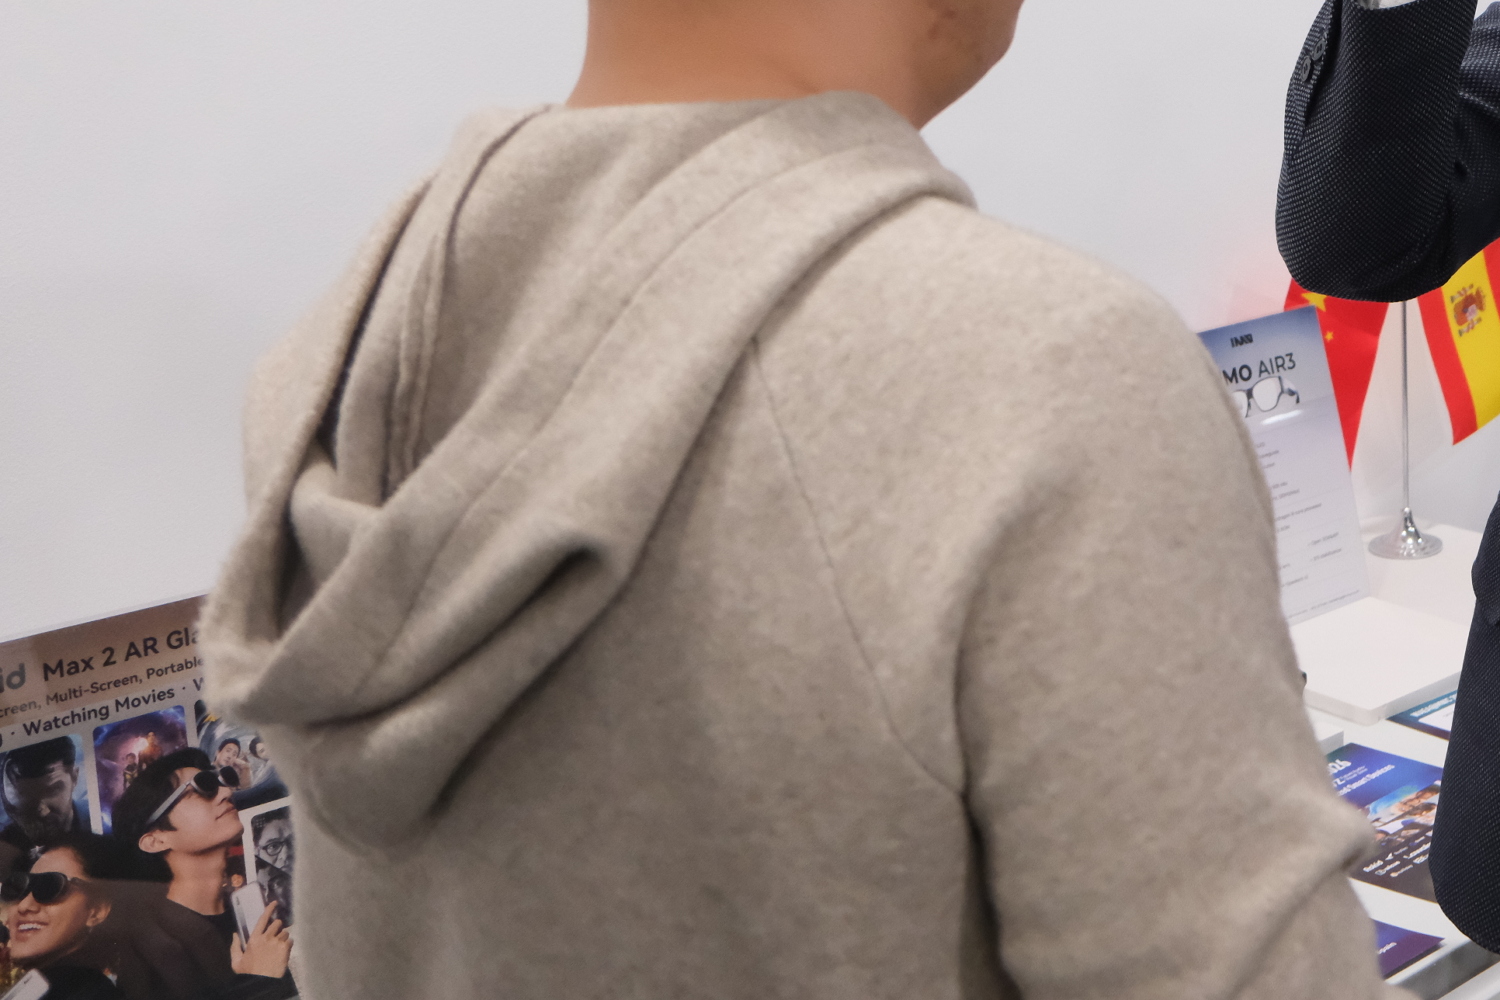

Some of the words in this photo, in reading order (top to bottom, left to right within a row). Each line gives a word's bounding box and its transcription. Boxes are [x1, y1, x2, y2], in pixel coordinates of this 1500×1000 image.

[1259, 352, 1296, 378] AIR3
[43, 656, 95, 682] Max
[102, 646, 117, 667] 2
[124, 636, 160, 662] AR
[46, 674, 143, 706] Multi-Screen,
[23, 705, 110, 736] Watching
[115, 687, 175, 713] Movies
